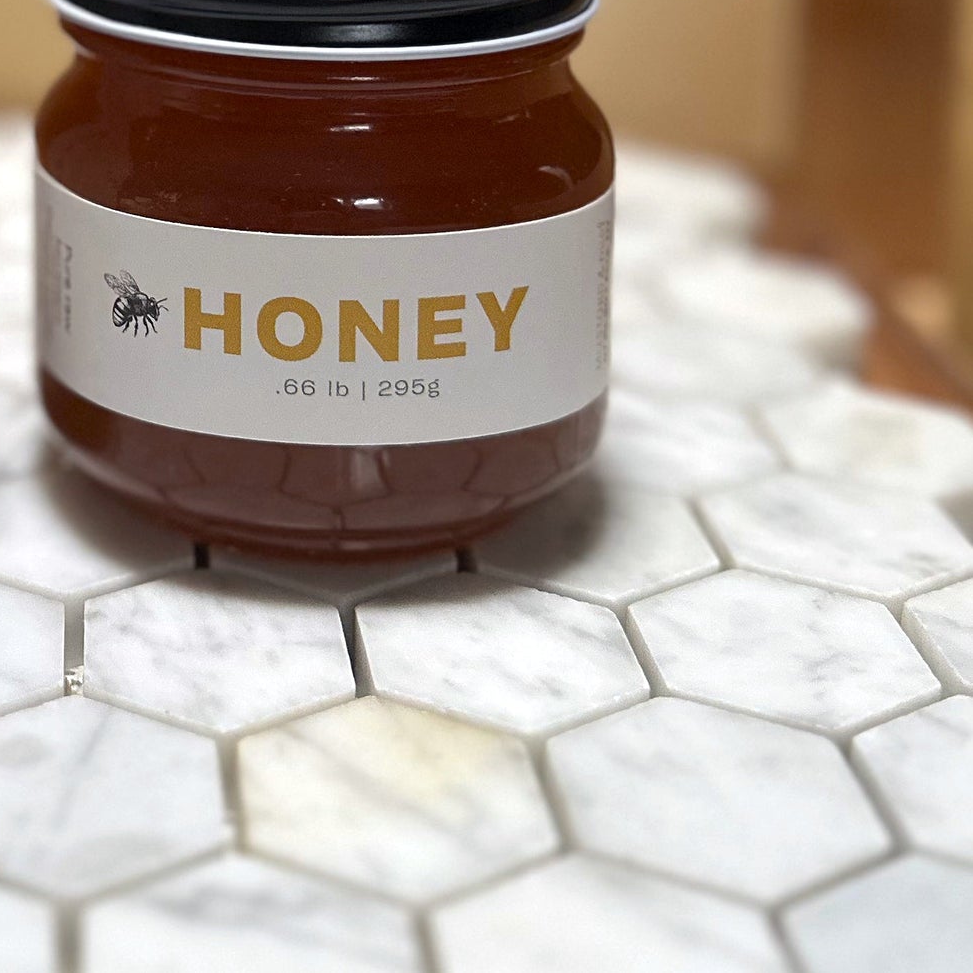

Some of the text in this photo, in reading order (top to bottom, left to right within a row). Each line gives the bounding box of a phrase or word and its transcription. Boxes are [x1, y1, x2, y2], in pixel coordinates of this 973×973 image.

[182, 285, 529, 363] HONEY
[275, 377, 317, 397] .66
[328, 378, 350, 398] lb
[377, 378, 441, 400] 295g
